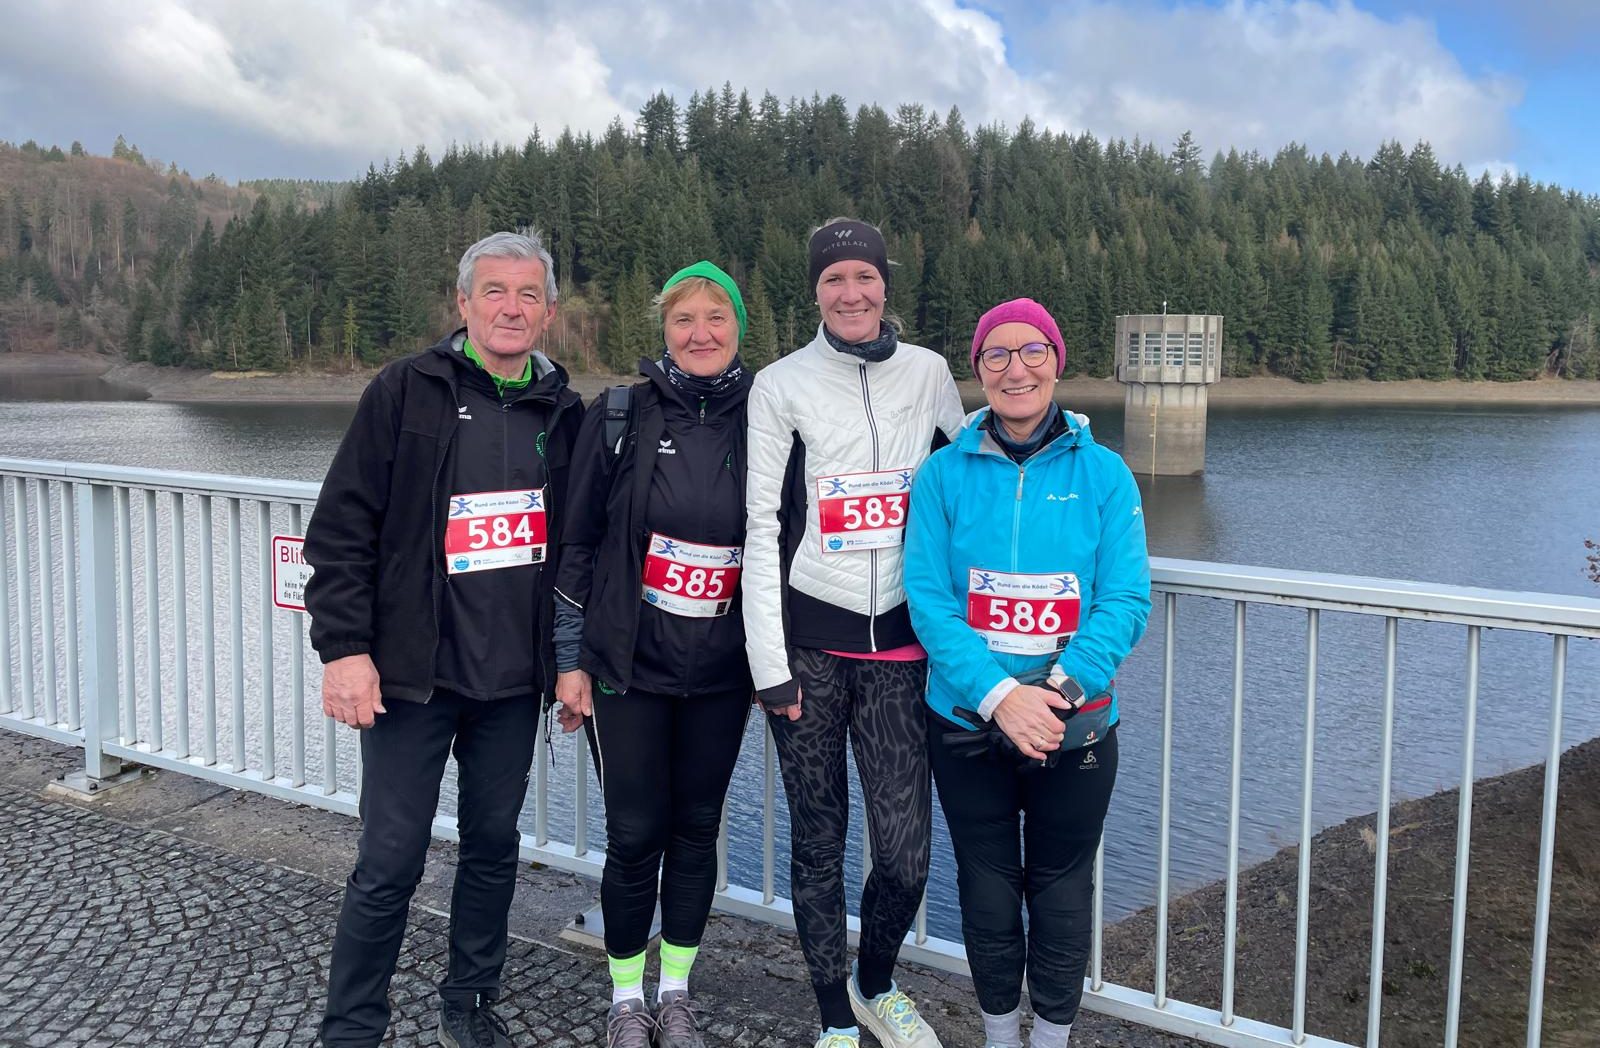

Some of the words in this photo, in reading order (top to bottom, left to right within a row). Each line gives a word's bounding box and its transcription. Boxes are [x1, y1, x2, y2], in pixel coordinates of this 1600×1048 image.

[843, 495, 905, 530] 583
[468, 514, 534, 550] 584
[281, 545, 304, 565] Blit
[284, 580, 297, 590] keine
[284, 590, 292, 599] die
[293, 591, 304, 601] Fläc
[663, 562, 726, 598] 585
[988, 598, 1062, 634] 586
